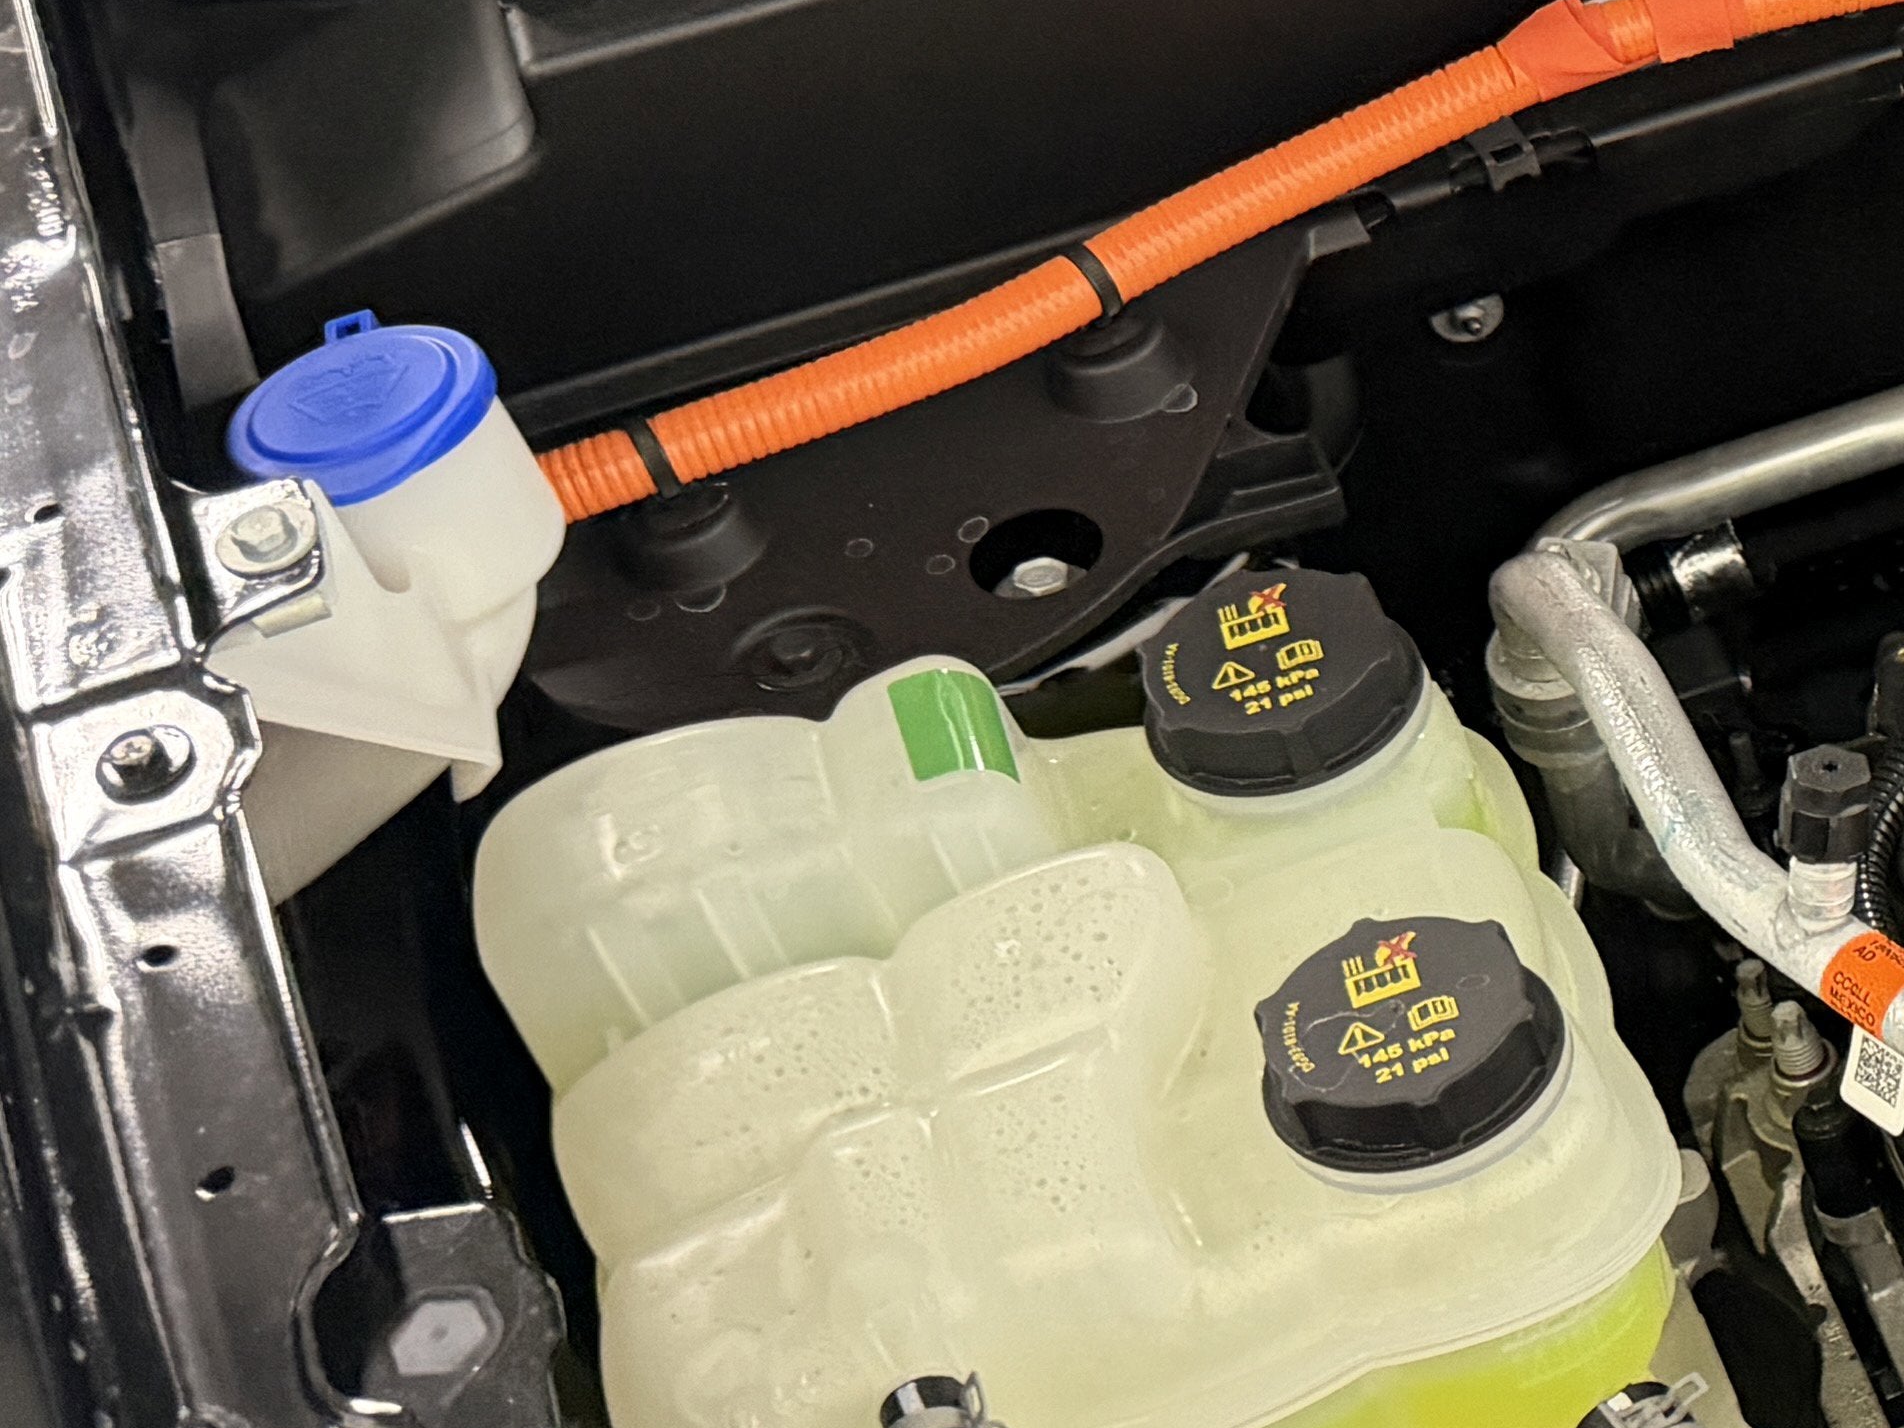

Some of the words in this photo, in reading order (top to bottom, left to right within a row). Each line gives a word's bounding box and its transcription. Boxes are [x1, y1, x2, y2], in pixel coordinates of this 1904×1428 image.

[1229, 680, 1272, 702] 145
[1275, 668, 1321, 689] kPa
[1244, 696, 1273, 716] 21
[1278, 684, 1314, 707] psi
[1358, 1042, 1404, 1069] 145
[1407, 1028, 1456, 1053] kPa
[1375, 1061, 1405, 1084] 21
[1412, 1046, 1450, 1073] psi
